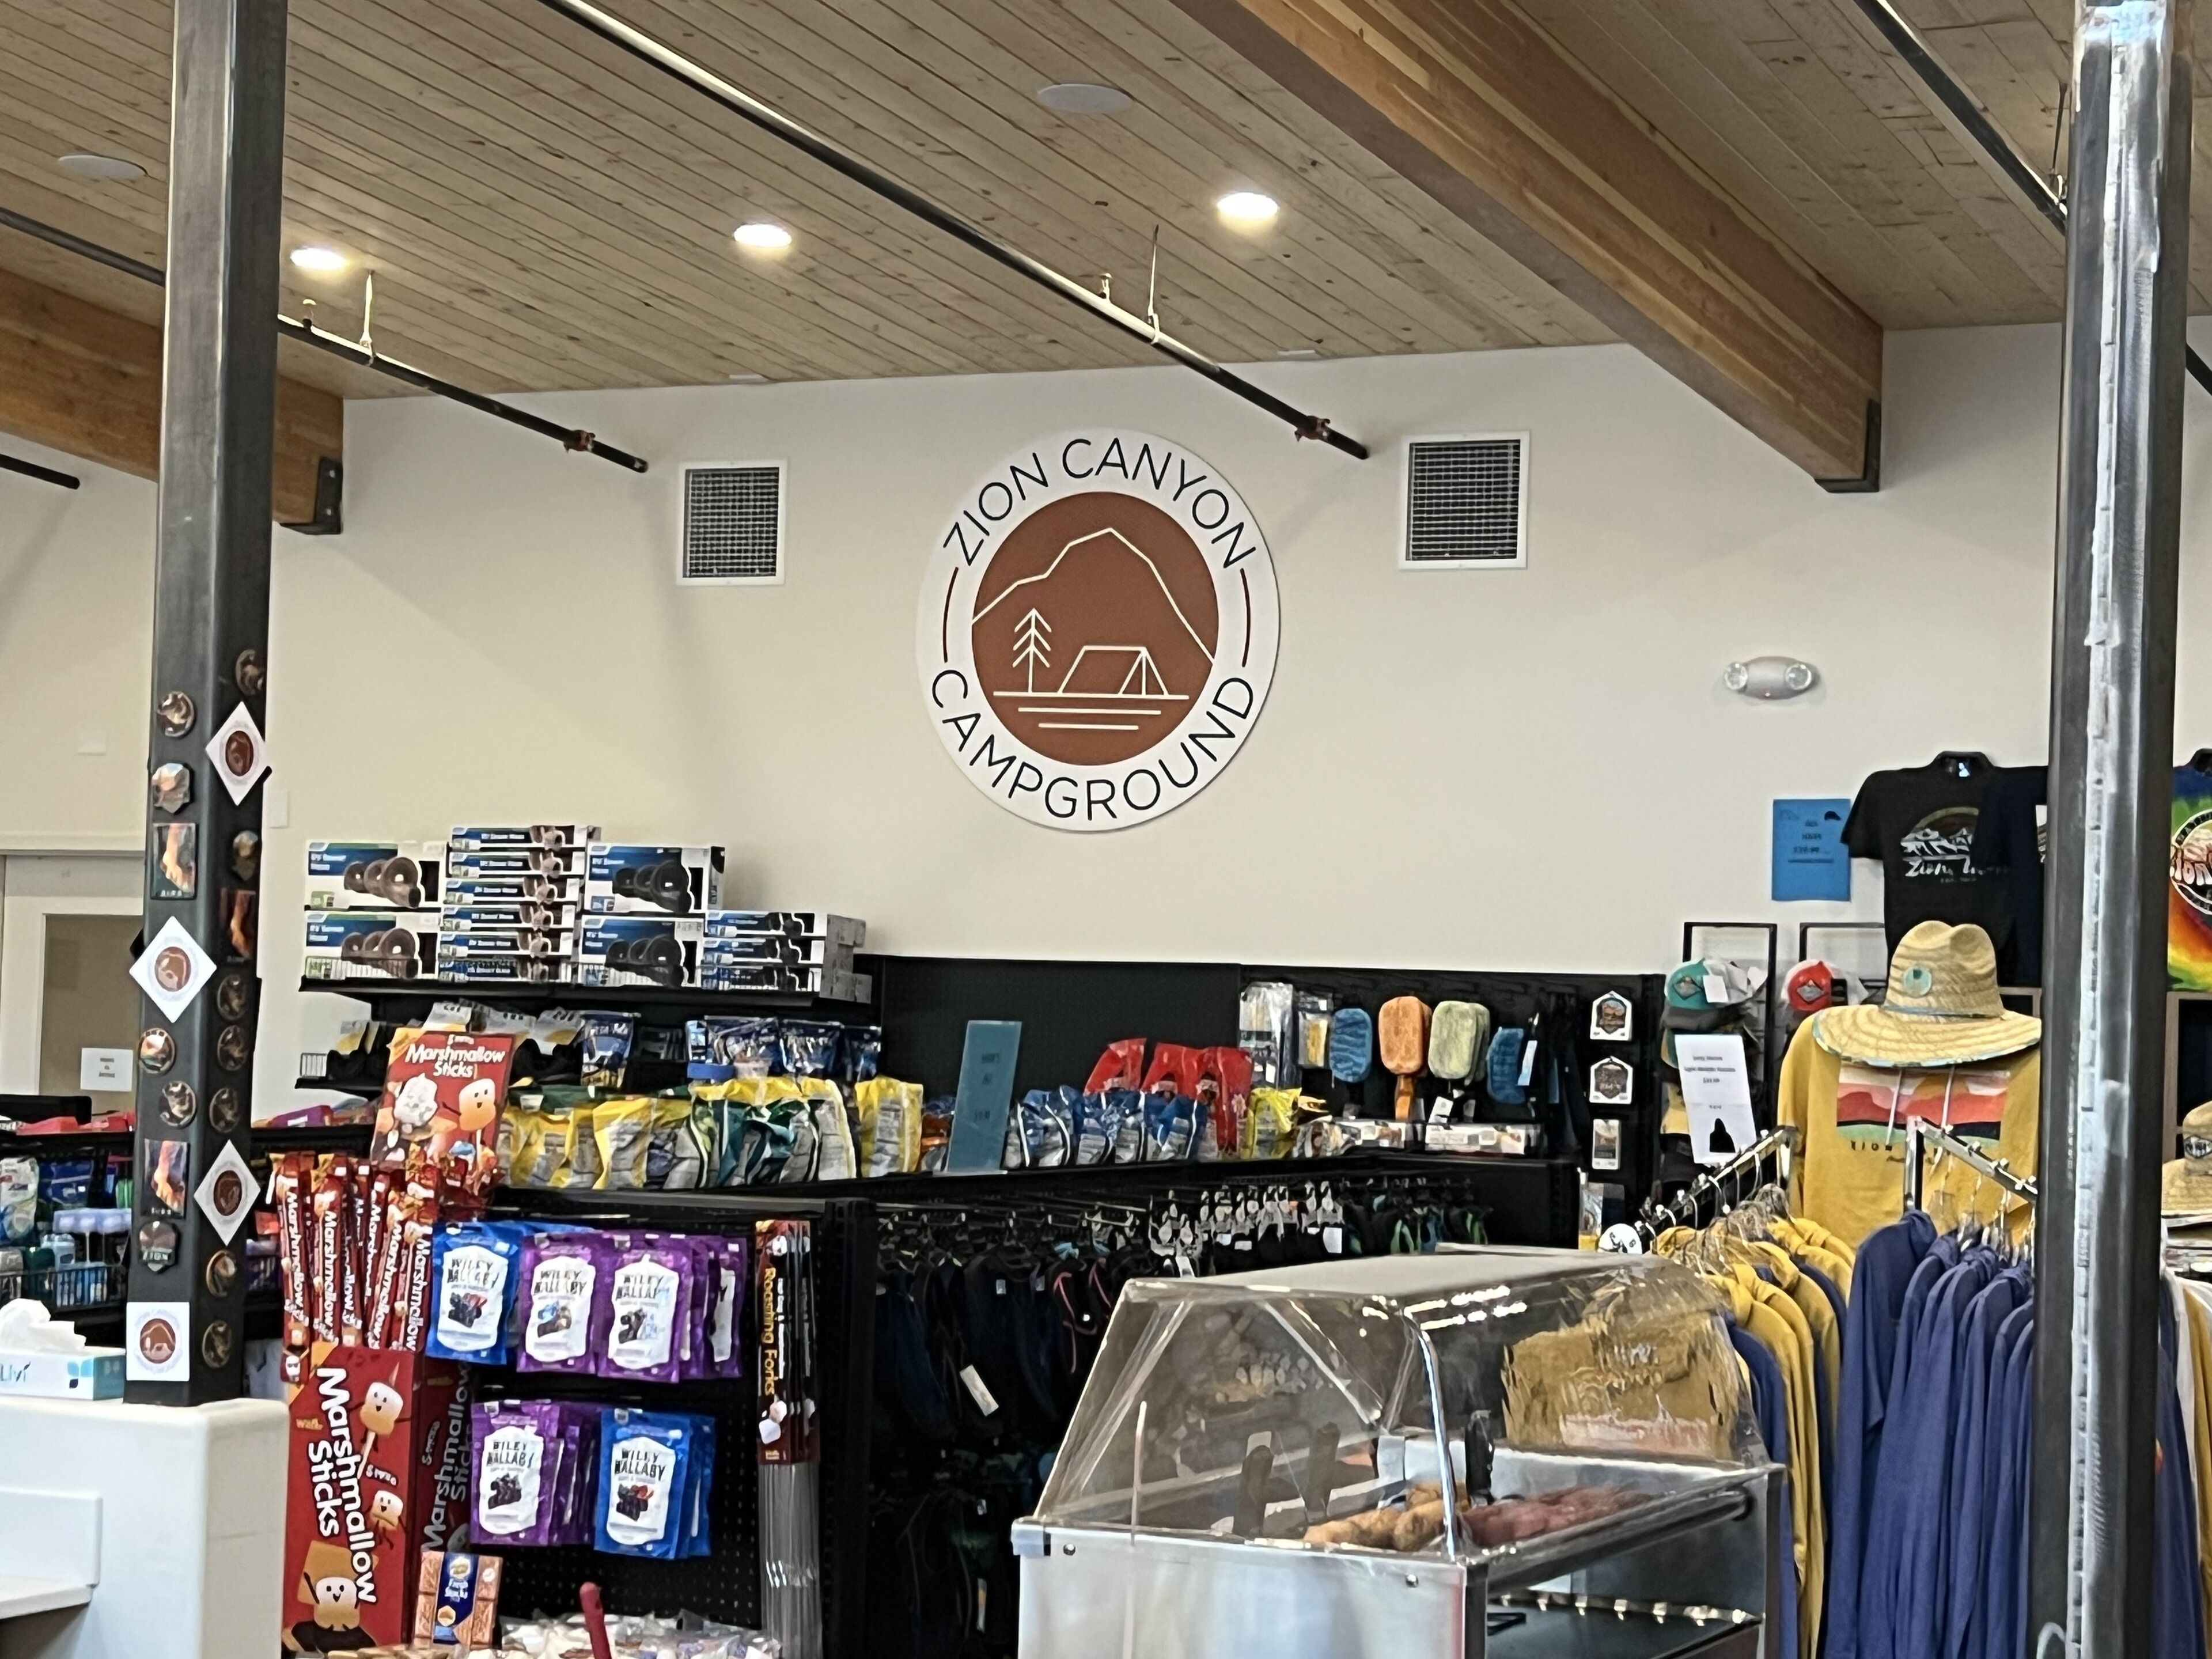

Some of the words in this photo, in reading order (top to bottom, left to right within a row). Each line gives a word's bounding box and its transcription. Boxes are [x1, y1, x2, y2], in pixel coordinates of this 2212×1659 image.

[942, 452, 1049, 566] ZION
[1062, 437, 1256, 569] CANYON
[931, 669, 1254, 821] CAMPGROUND
[405, 1043, 505, 1063] Marshmallow
[433, 1060, 474, 1078] Sticks
[308, 1440, 342, 1537] Sticks
[316, 1368, 377, 1603] Marshmallow
